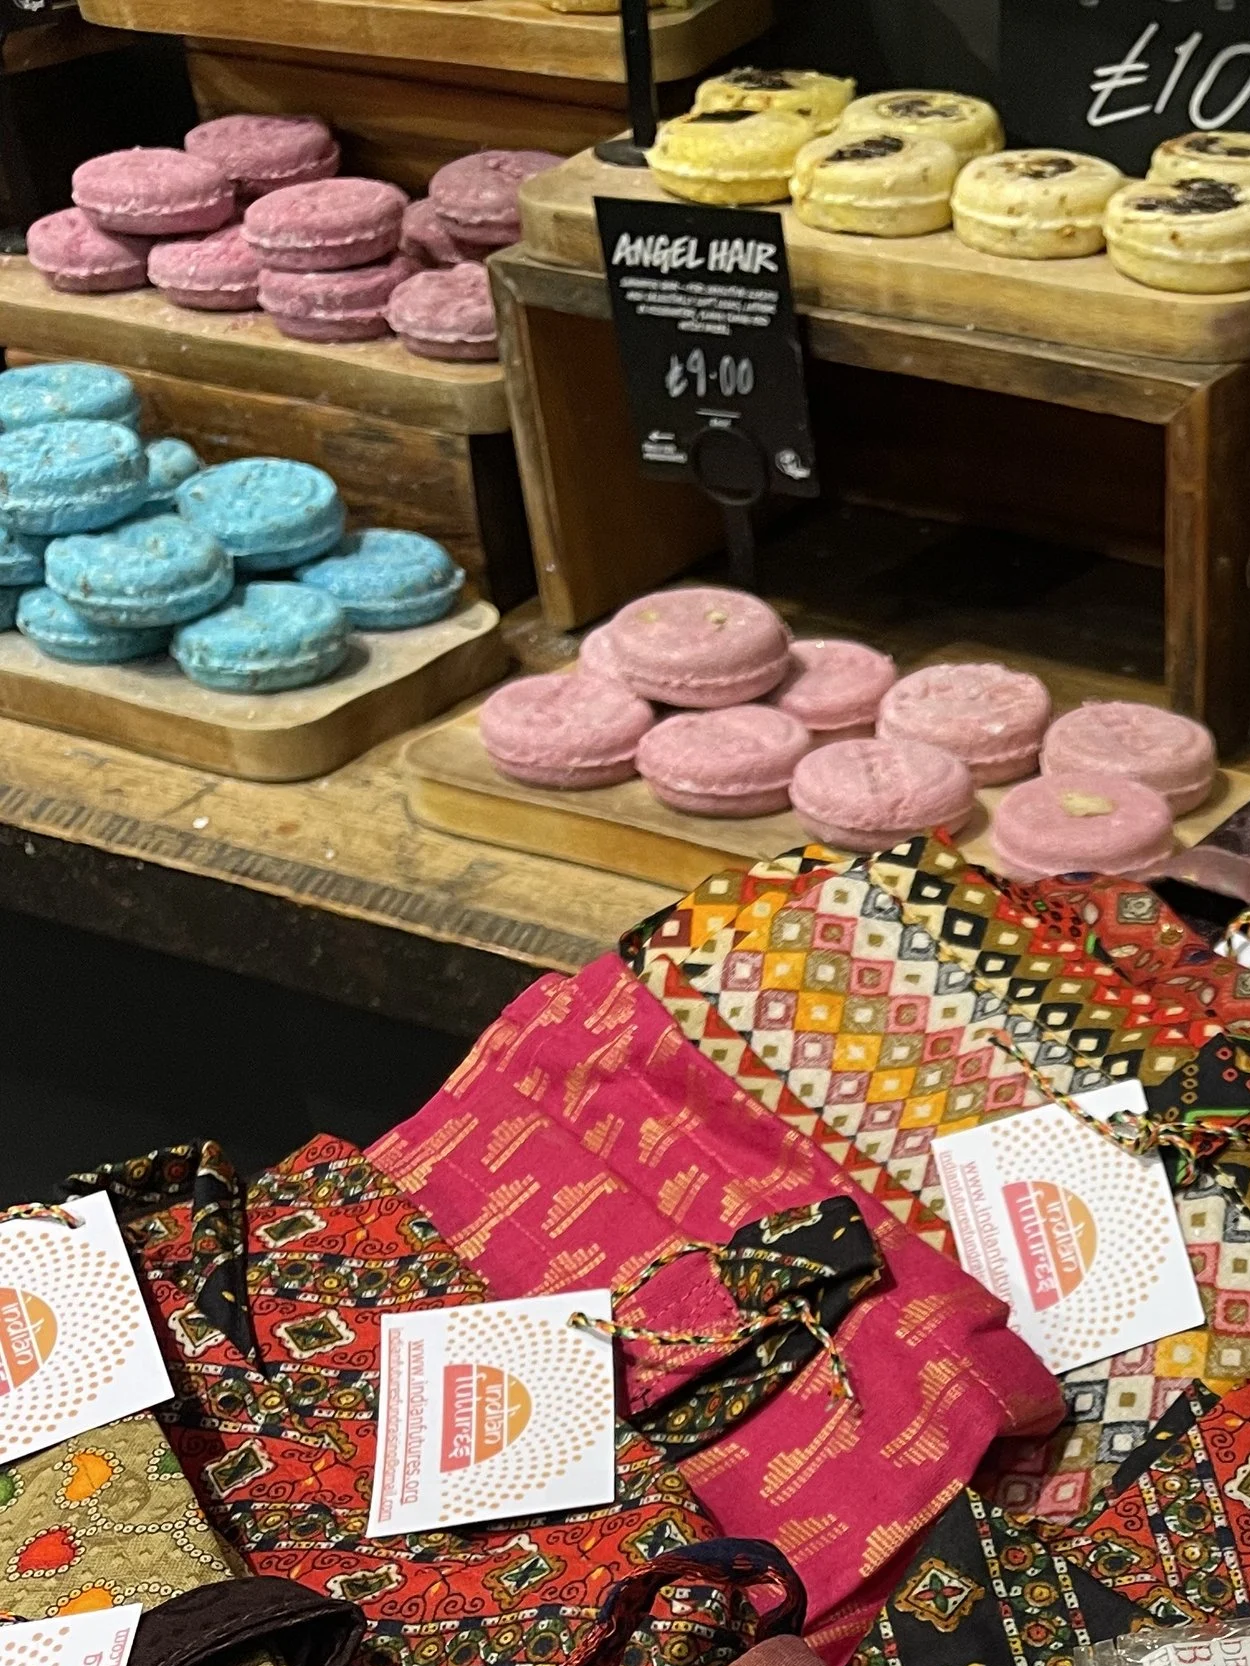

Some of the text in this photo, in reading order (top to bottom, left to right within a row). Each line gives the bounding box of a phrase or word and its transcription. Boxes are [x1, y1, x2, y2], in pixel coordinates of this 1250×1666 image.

[612, 232, 778, 274] ANGEL HAIR
[1046, 1195, 1085, 1272] indian
[403, 1339, 427, 1504] www.indianfutures.org
[483, 1379, 521, 1445] indian
